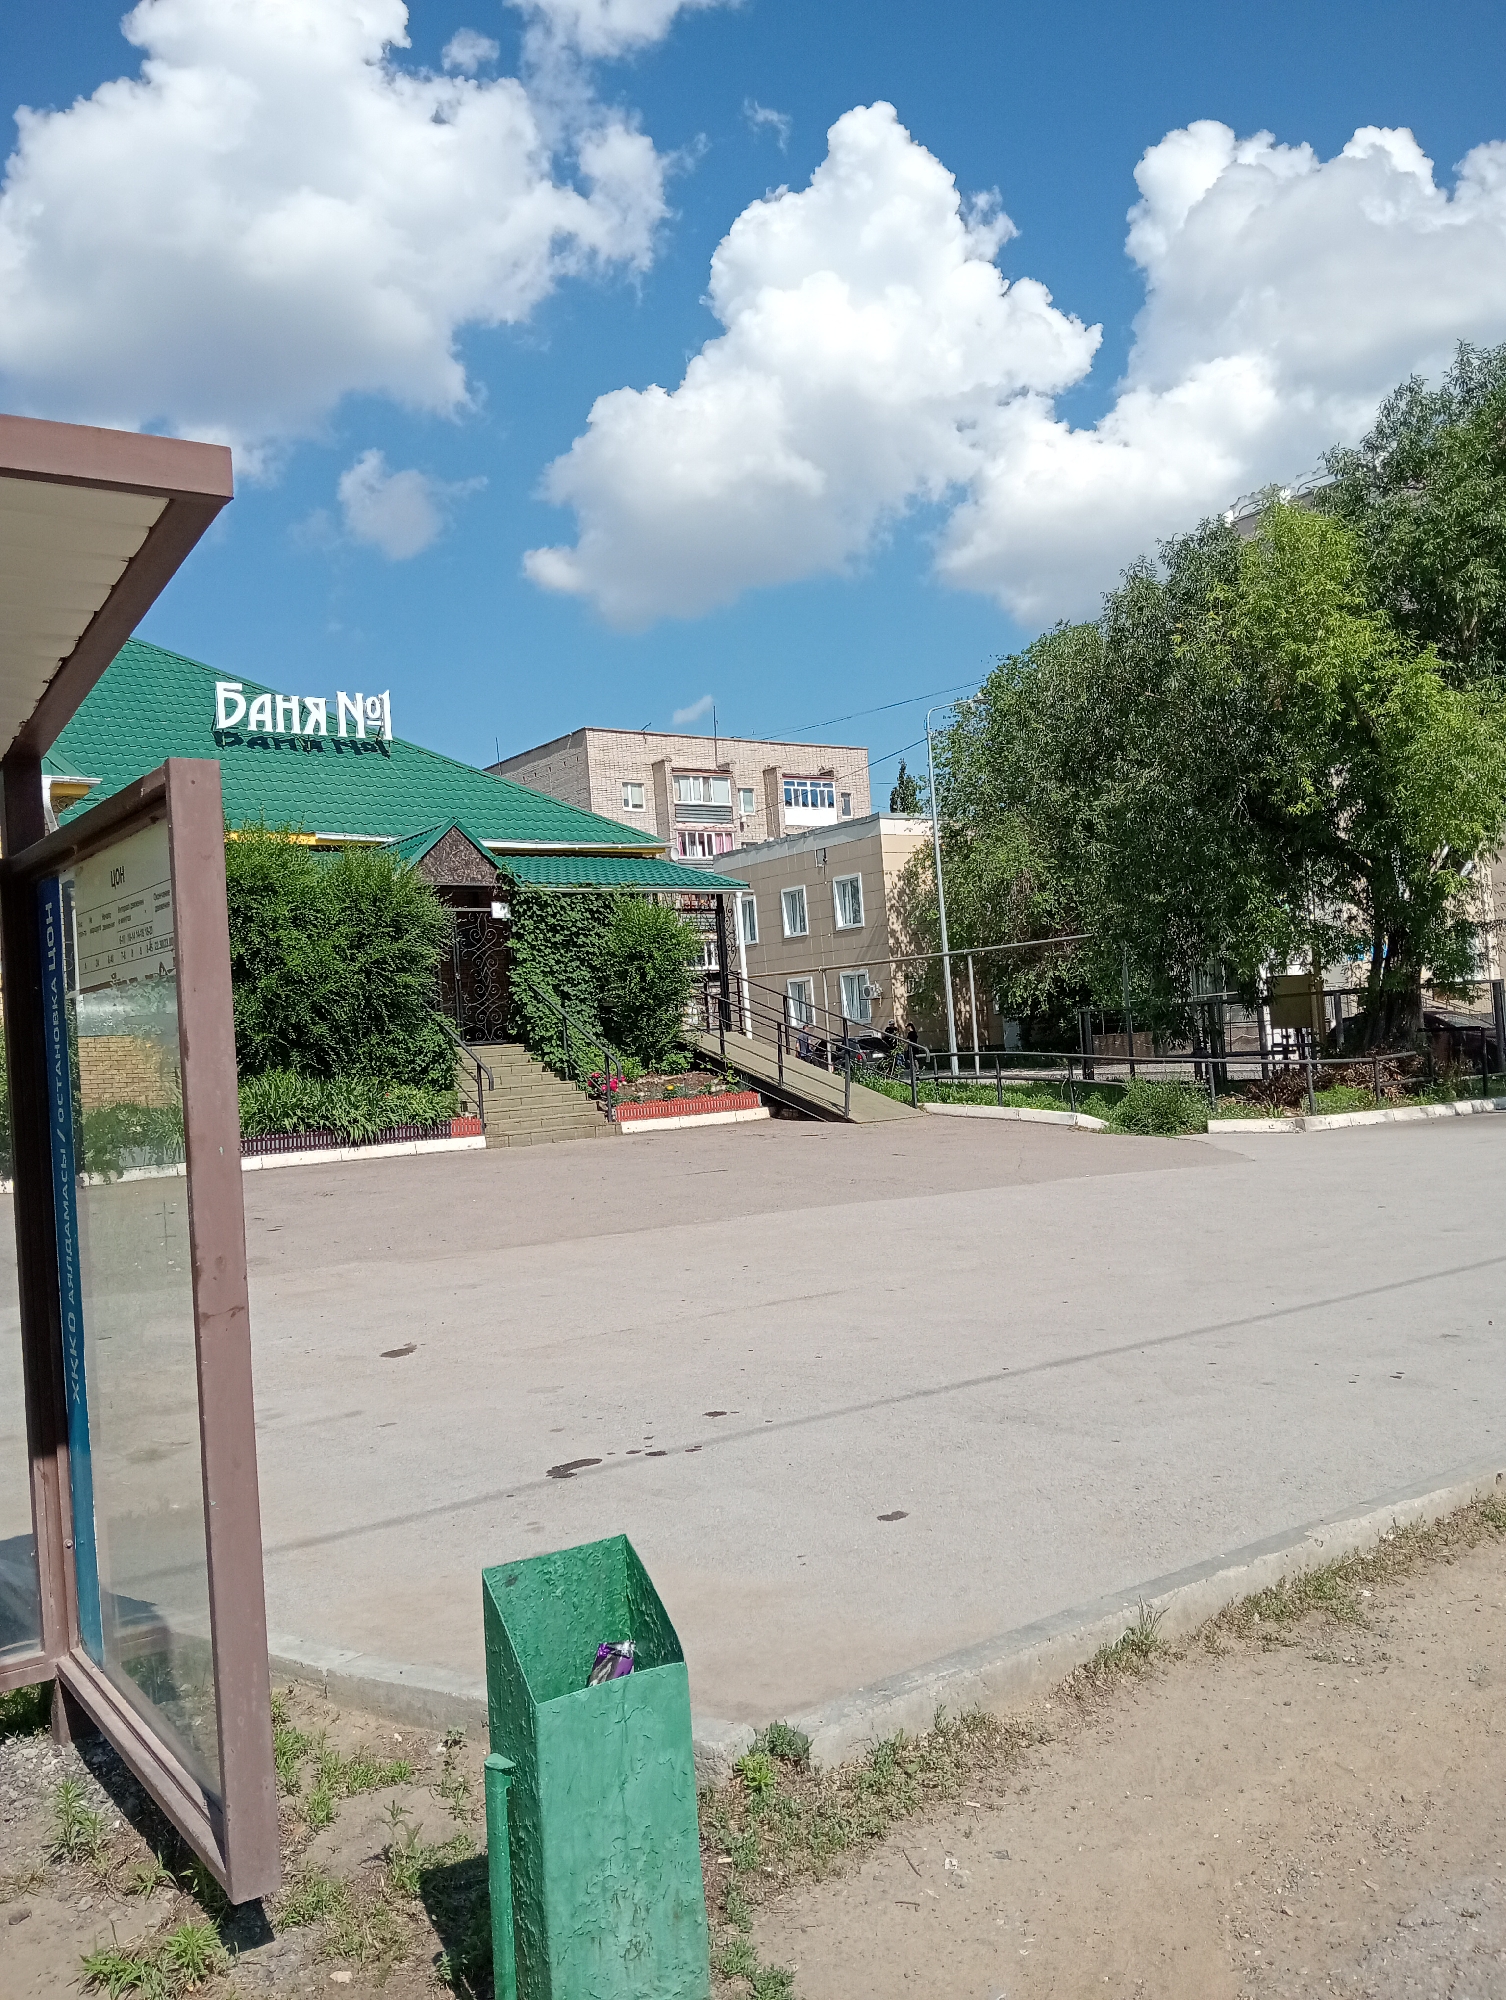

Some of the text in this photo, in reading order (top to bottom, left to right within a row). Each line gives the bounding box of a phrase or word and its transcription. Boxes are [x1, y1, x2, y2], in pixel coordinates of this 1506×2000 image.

[110, 866, 126, 890] ЦОН
[45, 902, 57, 971] ЦОН
[50, 977, 65, 1123] ОСТАНОВКА
[60, 1149, 74, 1304] АЯЛДАМАСЫ
